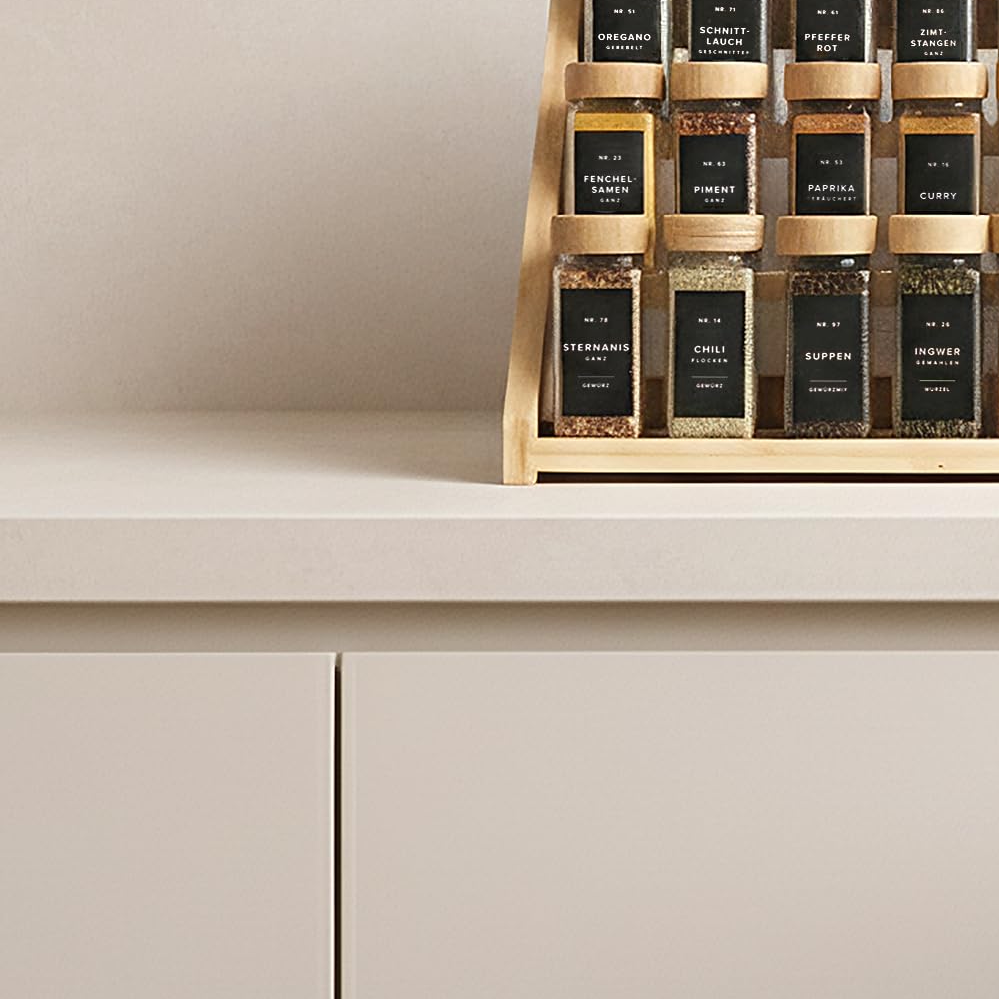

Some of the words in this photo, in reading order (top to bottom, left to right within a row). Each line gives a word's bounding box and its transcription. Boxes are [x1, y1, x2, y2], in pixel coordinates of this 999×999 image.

[699, 26, 750, 35] SCHNITT-
[920, 28, 947, 36] ZIMT-
[597, 33, 652, 42] OREGANO
[706, 37, 743, 46] LAUCH
[804, 33, 851, 42] PFEFFER
[910, 39, 957, 47] STANGEN
[816, 44, 838, 53] ROT
[583, 175, 637, 183] FENCHEL-
[591, 185, 629, 194] SAMEN
[693, 185, 736, 194] PIMENT
[807, 184, 855, 193] PAPRIKA
[919, 192, 957, 200] CURRY
[563, 343, 630, 352] STERNANIS
[693, 345, 725, 354] CHILI
[914, 347, 961, 356] INGWER
[805, 351, 852, 361] SUPPEN
